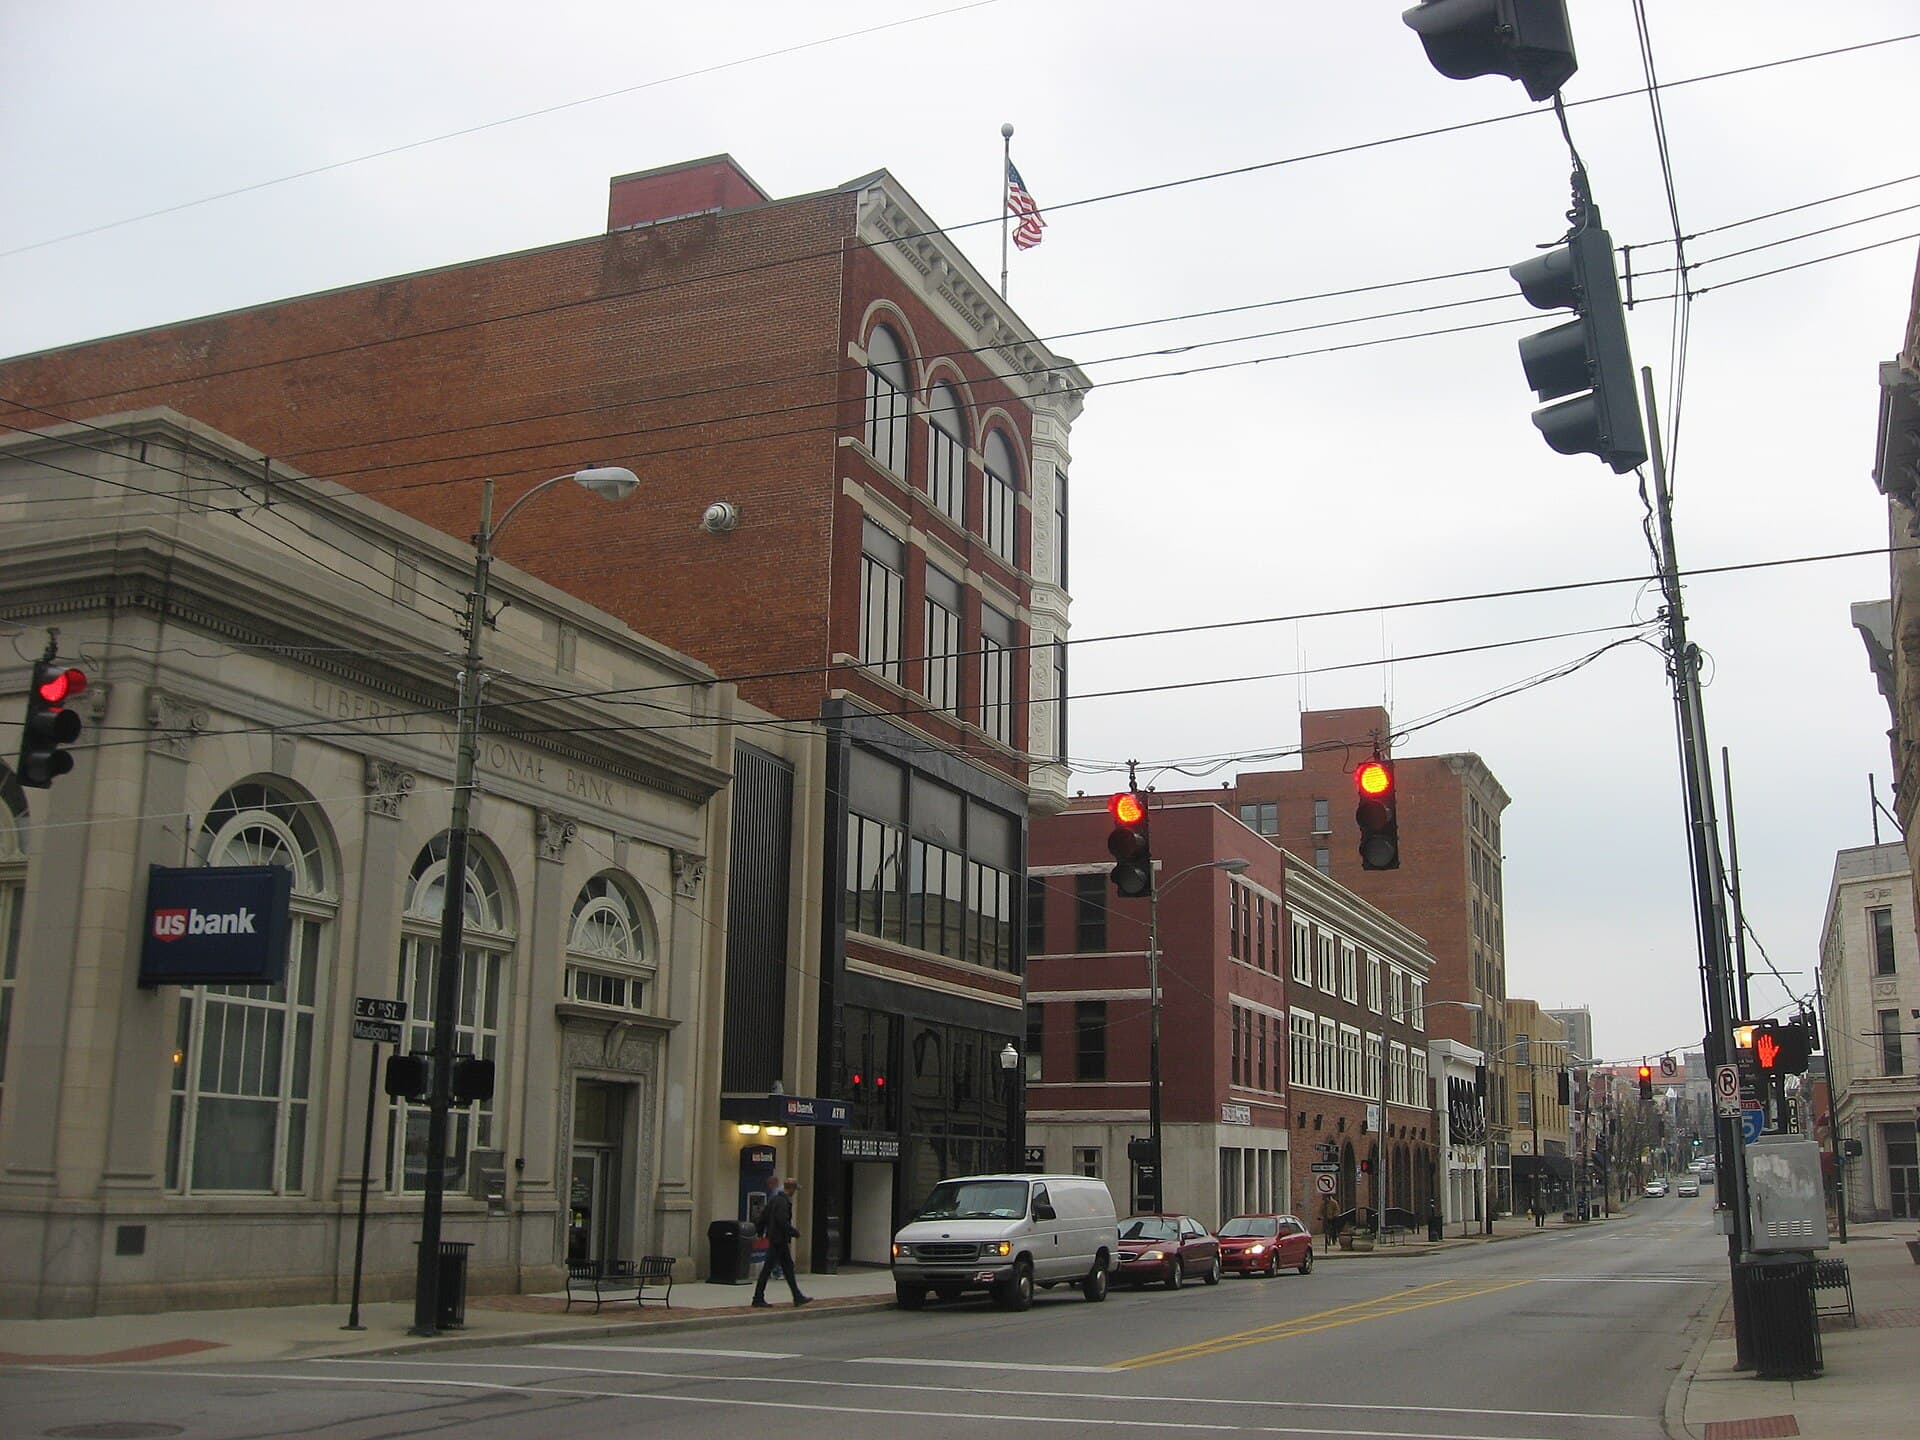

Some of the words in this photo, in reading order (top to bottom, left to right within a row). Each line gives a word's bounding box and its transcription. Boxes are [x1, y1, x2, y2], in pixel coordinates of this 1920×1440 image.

[313, 680, 410, 736] LIBERTY
[440, 724, 545, 783] NIONAL
[567, 768, 613, 806] BANK
[831, 1107, 846, 1119] ATM
